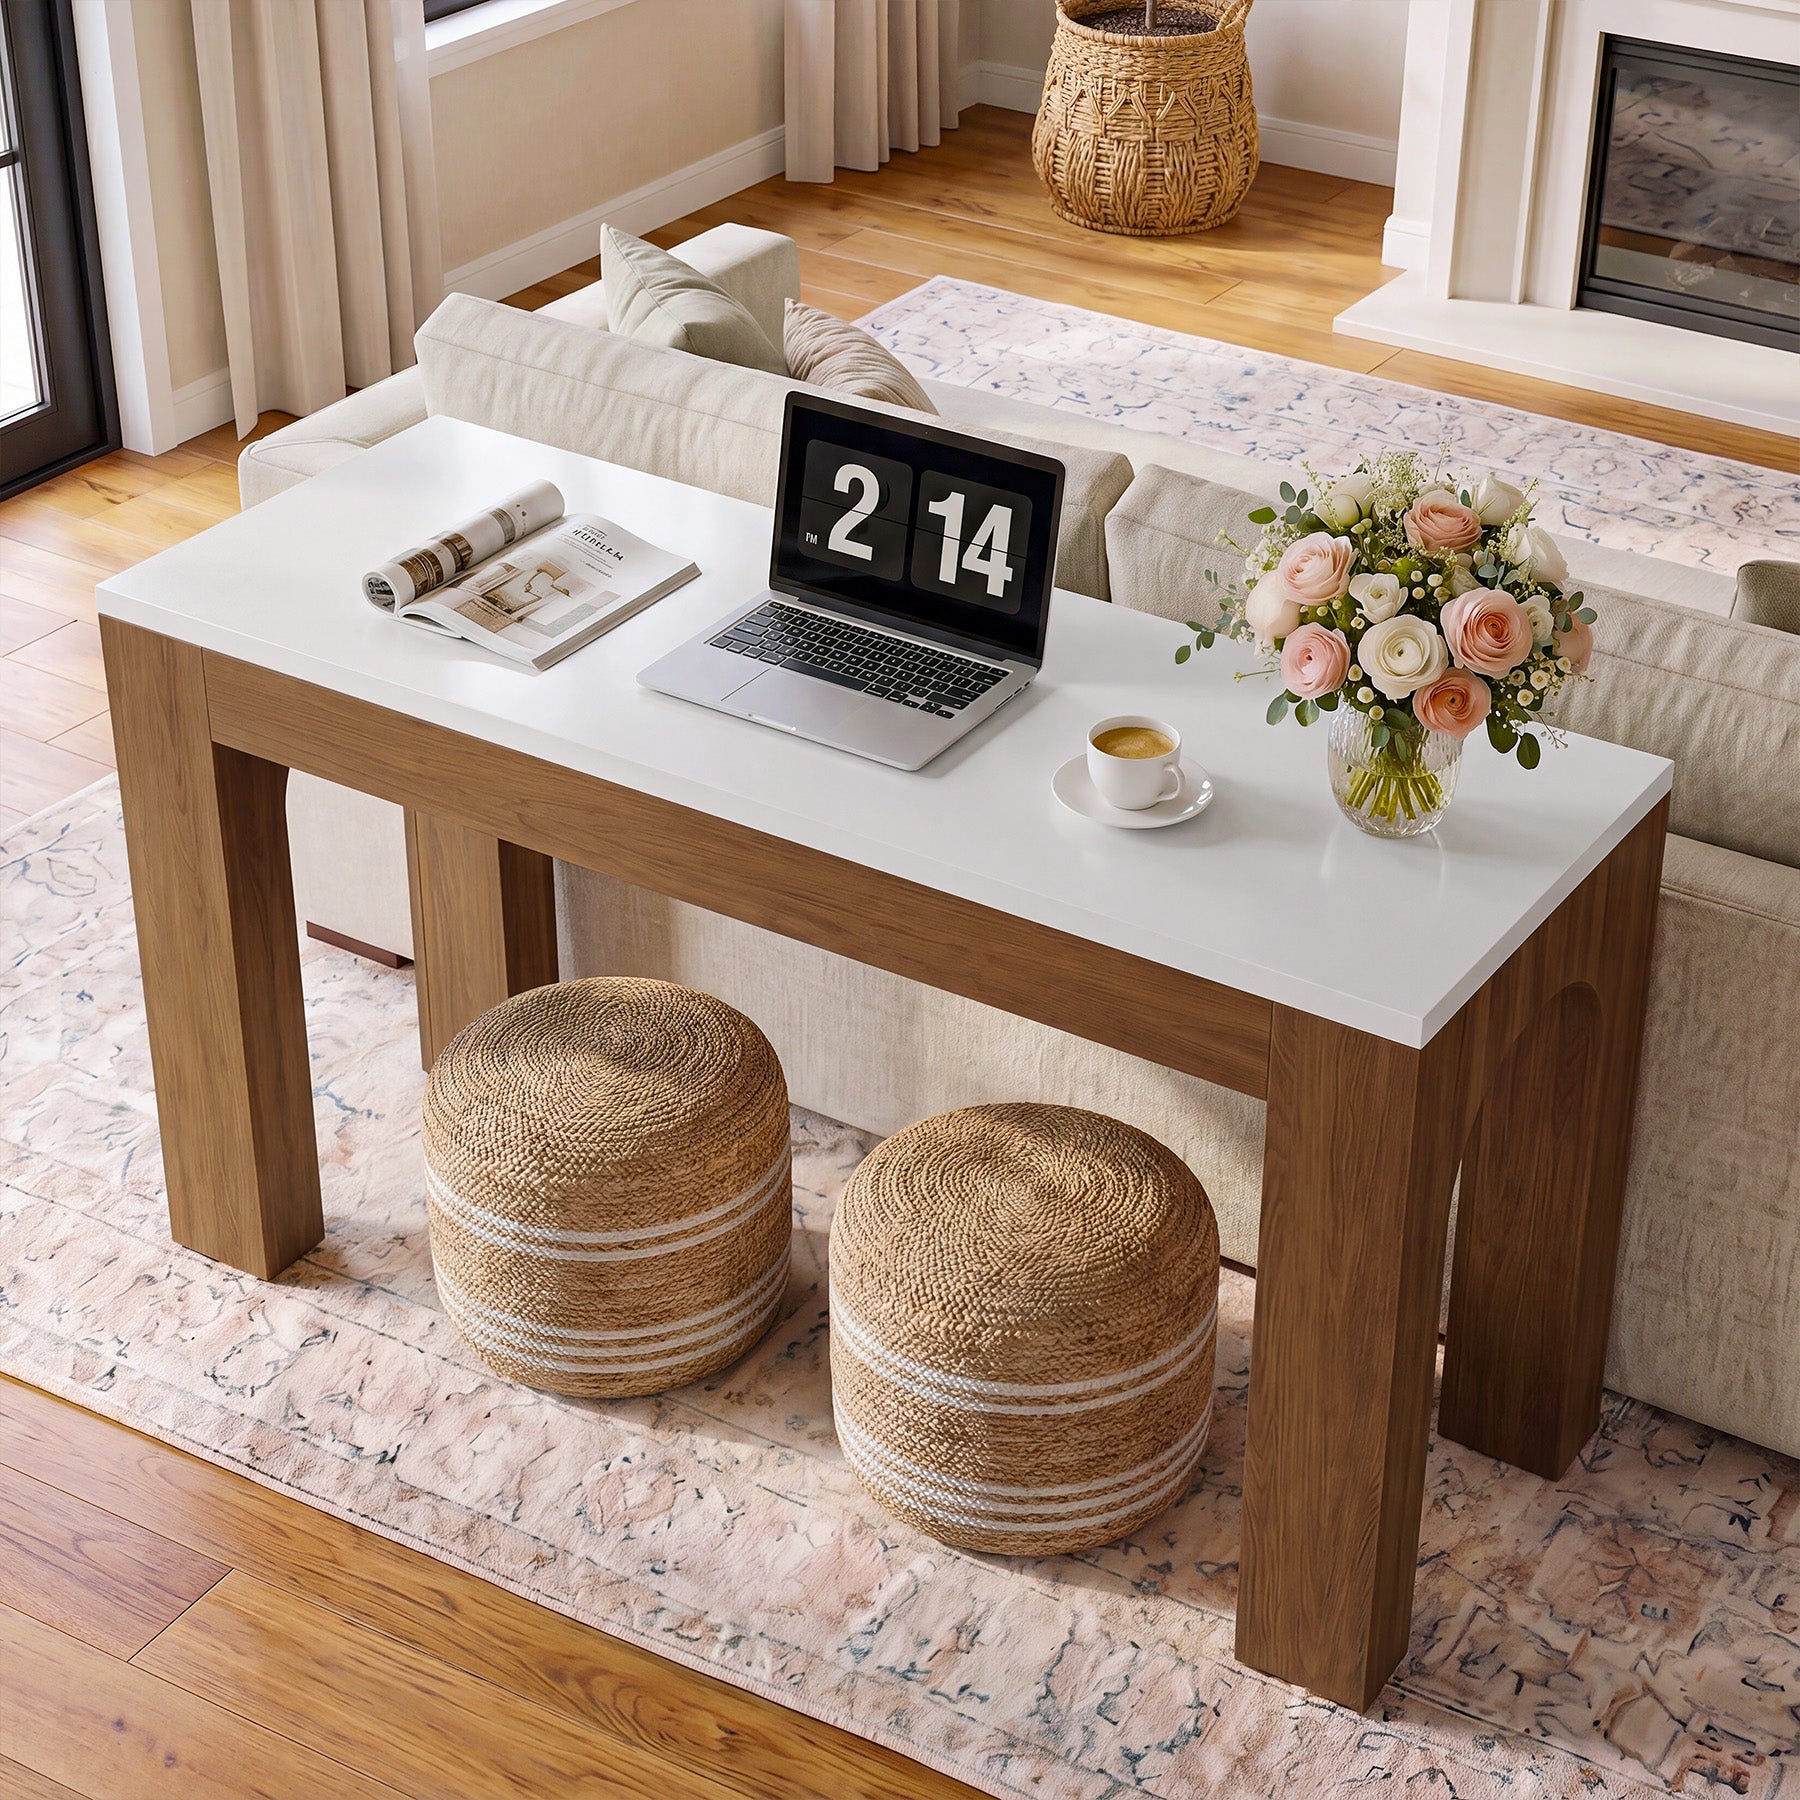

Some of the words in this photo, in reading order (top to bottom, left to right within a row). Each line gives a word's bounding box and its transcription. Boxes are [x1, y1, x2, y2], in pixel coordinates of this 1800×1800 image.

[805, 532, 818, 545] PM
[828, 463, 880, 561] 2
[928, 491, 1013, 598] 14
